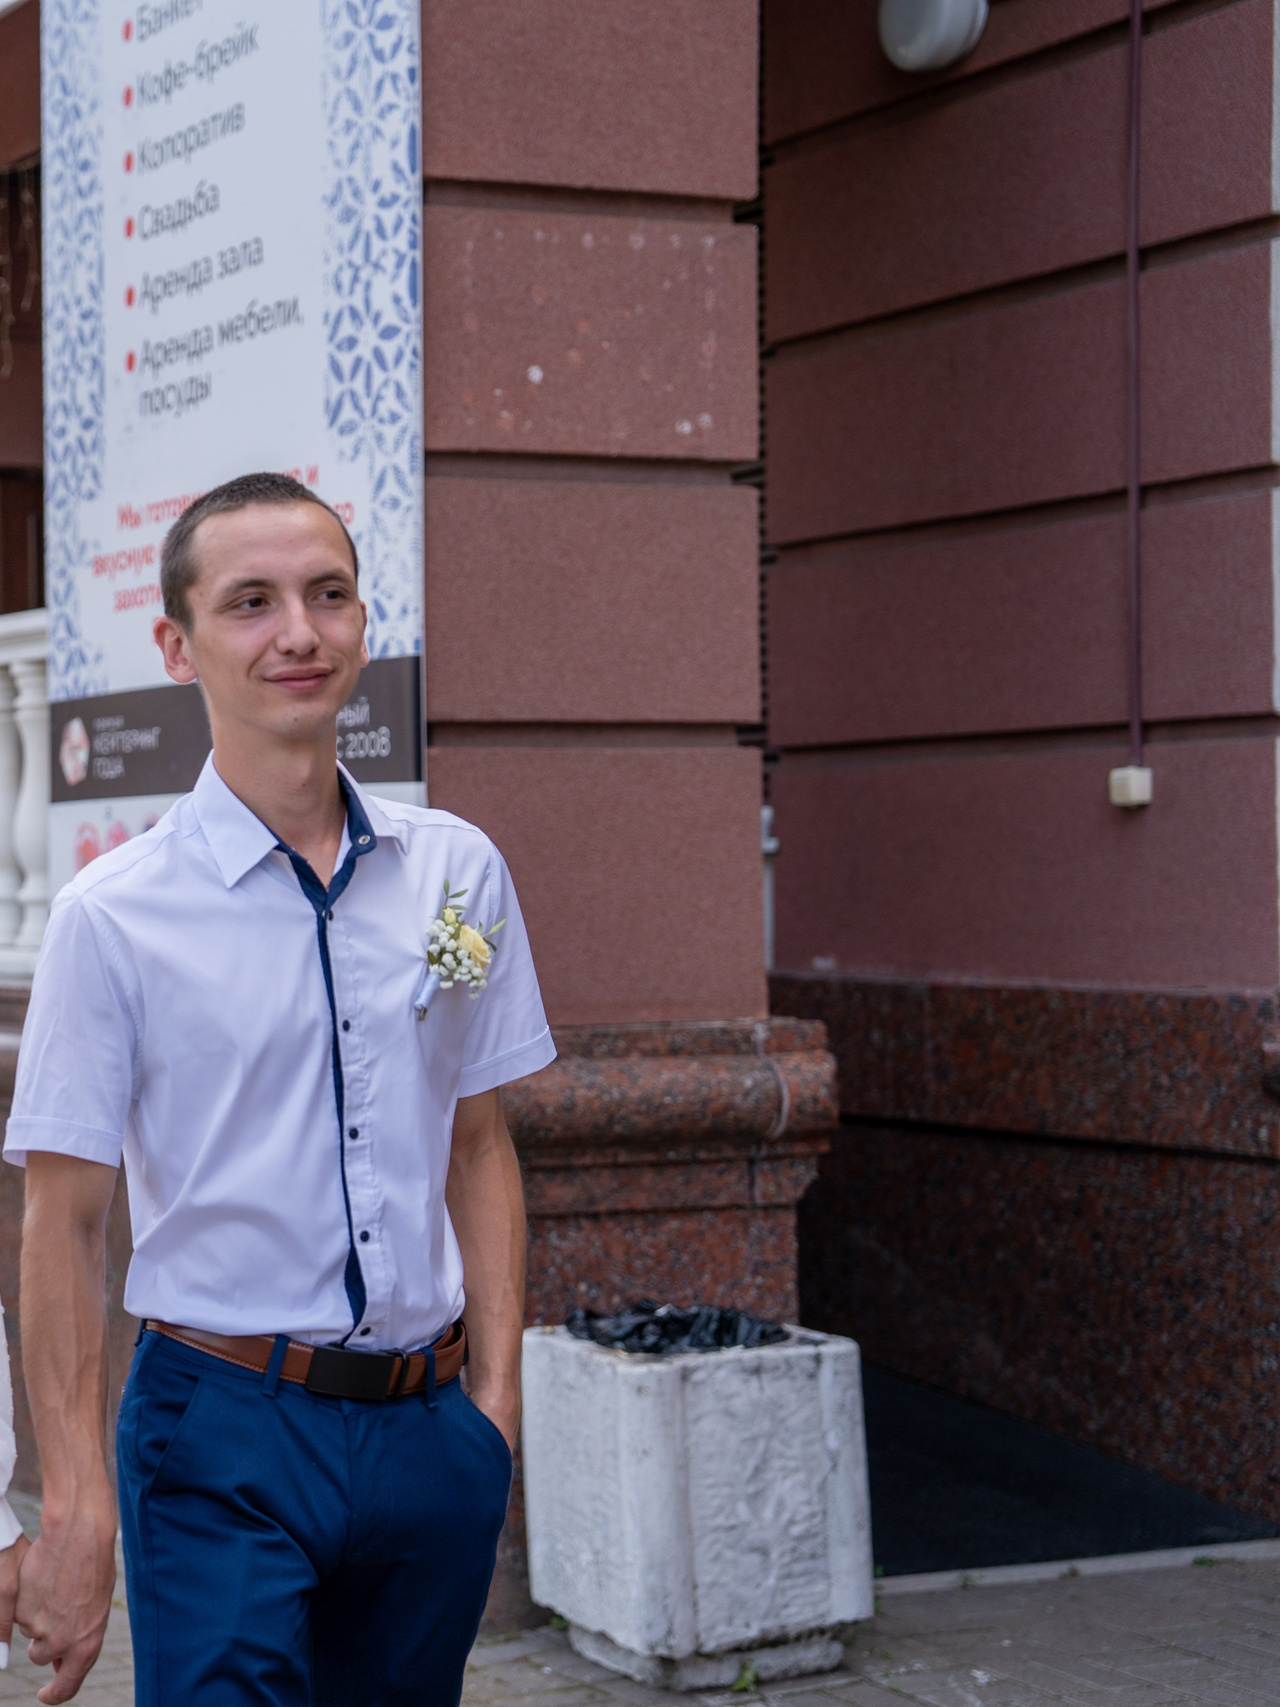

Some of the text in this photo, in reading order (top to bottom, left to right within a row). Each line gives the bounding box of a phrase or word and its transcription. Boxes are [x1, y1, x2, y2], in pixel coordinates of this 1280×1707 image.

[137, 21, 260, 107] Кофе-брейк
[138, 179, 220, 241] Свадьба
[138, 236, 264, 315] Аренда зала
[138, 322, 214, 380] Аренда
[139, 373, 212, 419] посуды
[345, 726, 392, 759] 2008
